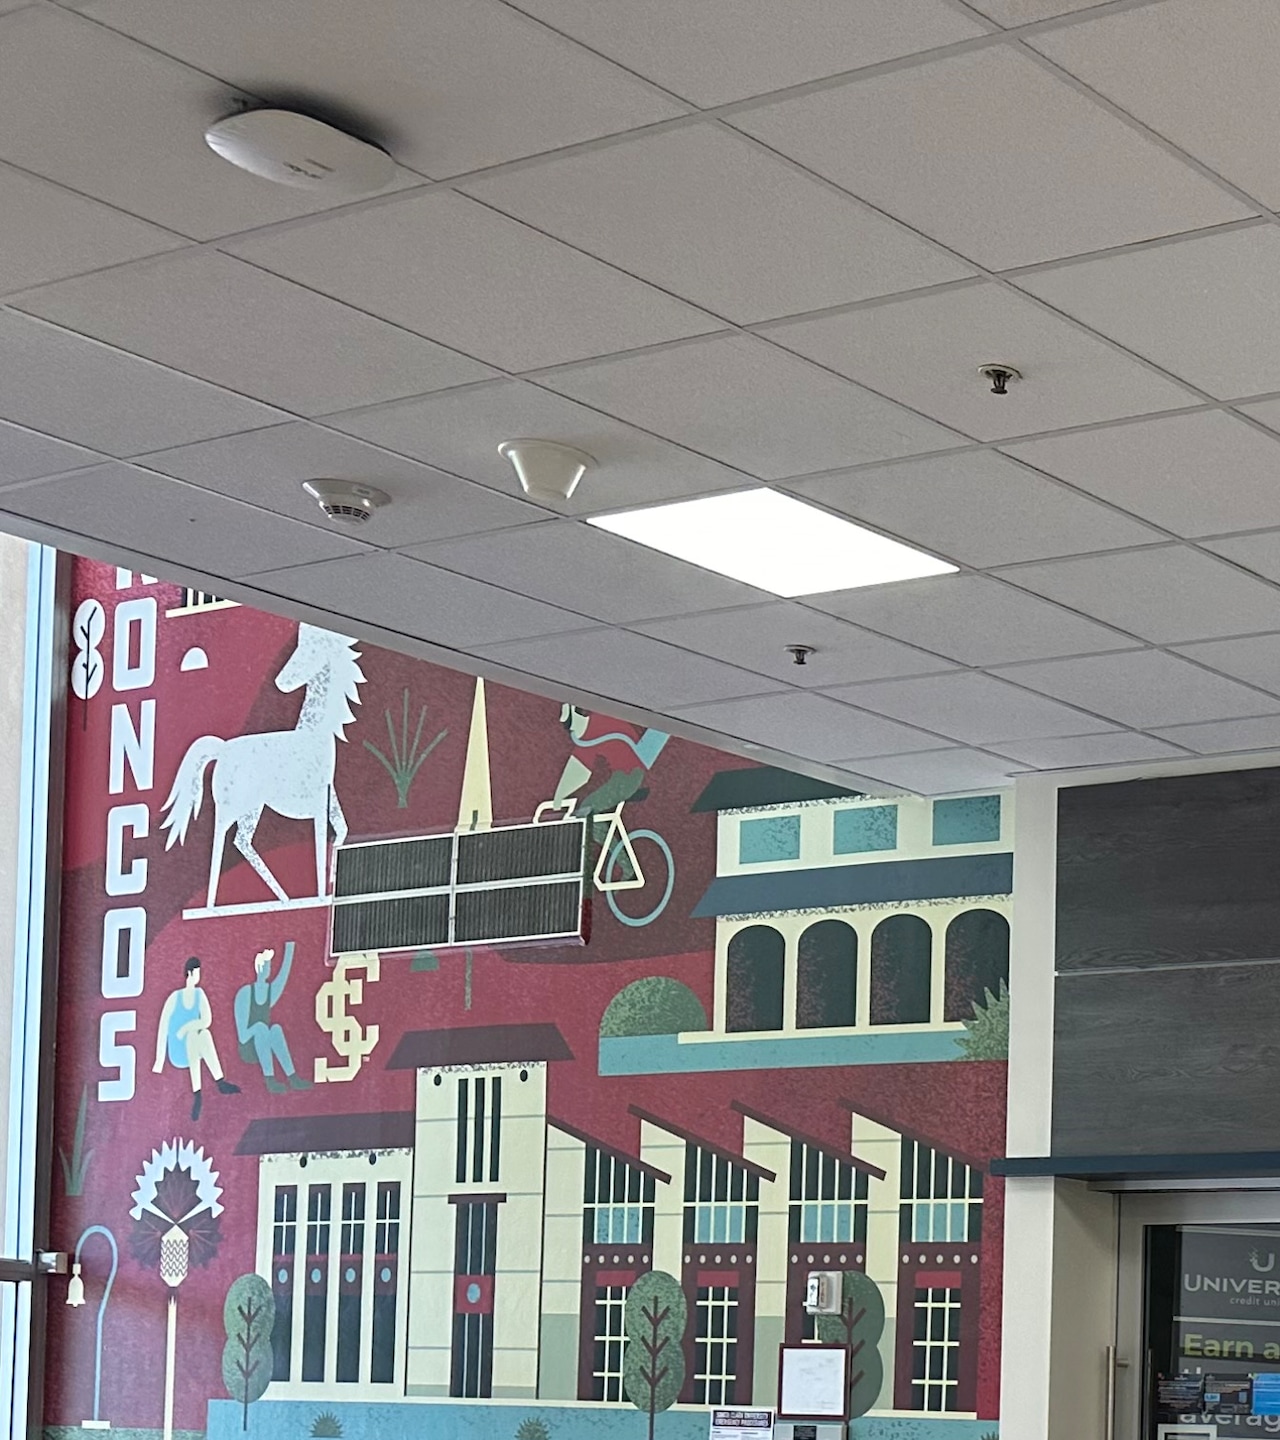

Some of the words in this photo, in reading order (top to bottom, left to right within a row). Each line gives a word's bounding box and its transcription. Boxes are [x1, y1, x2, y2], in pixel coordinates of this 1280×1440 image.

[98, 567, 158, 1102] ONCOS
[1230, 1295, 1260, 1306] credit
[1184, 1333, 1254, 1358] Earn
